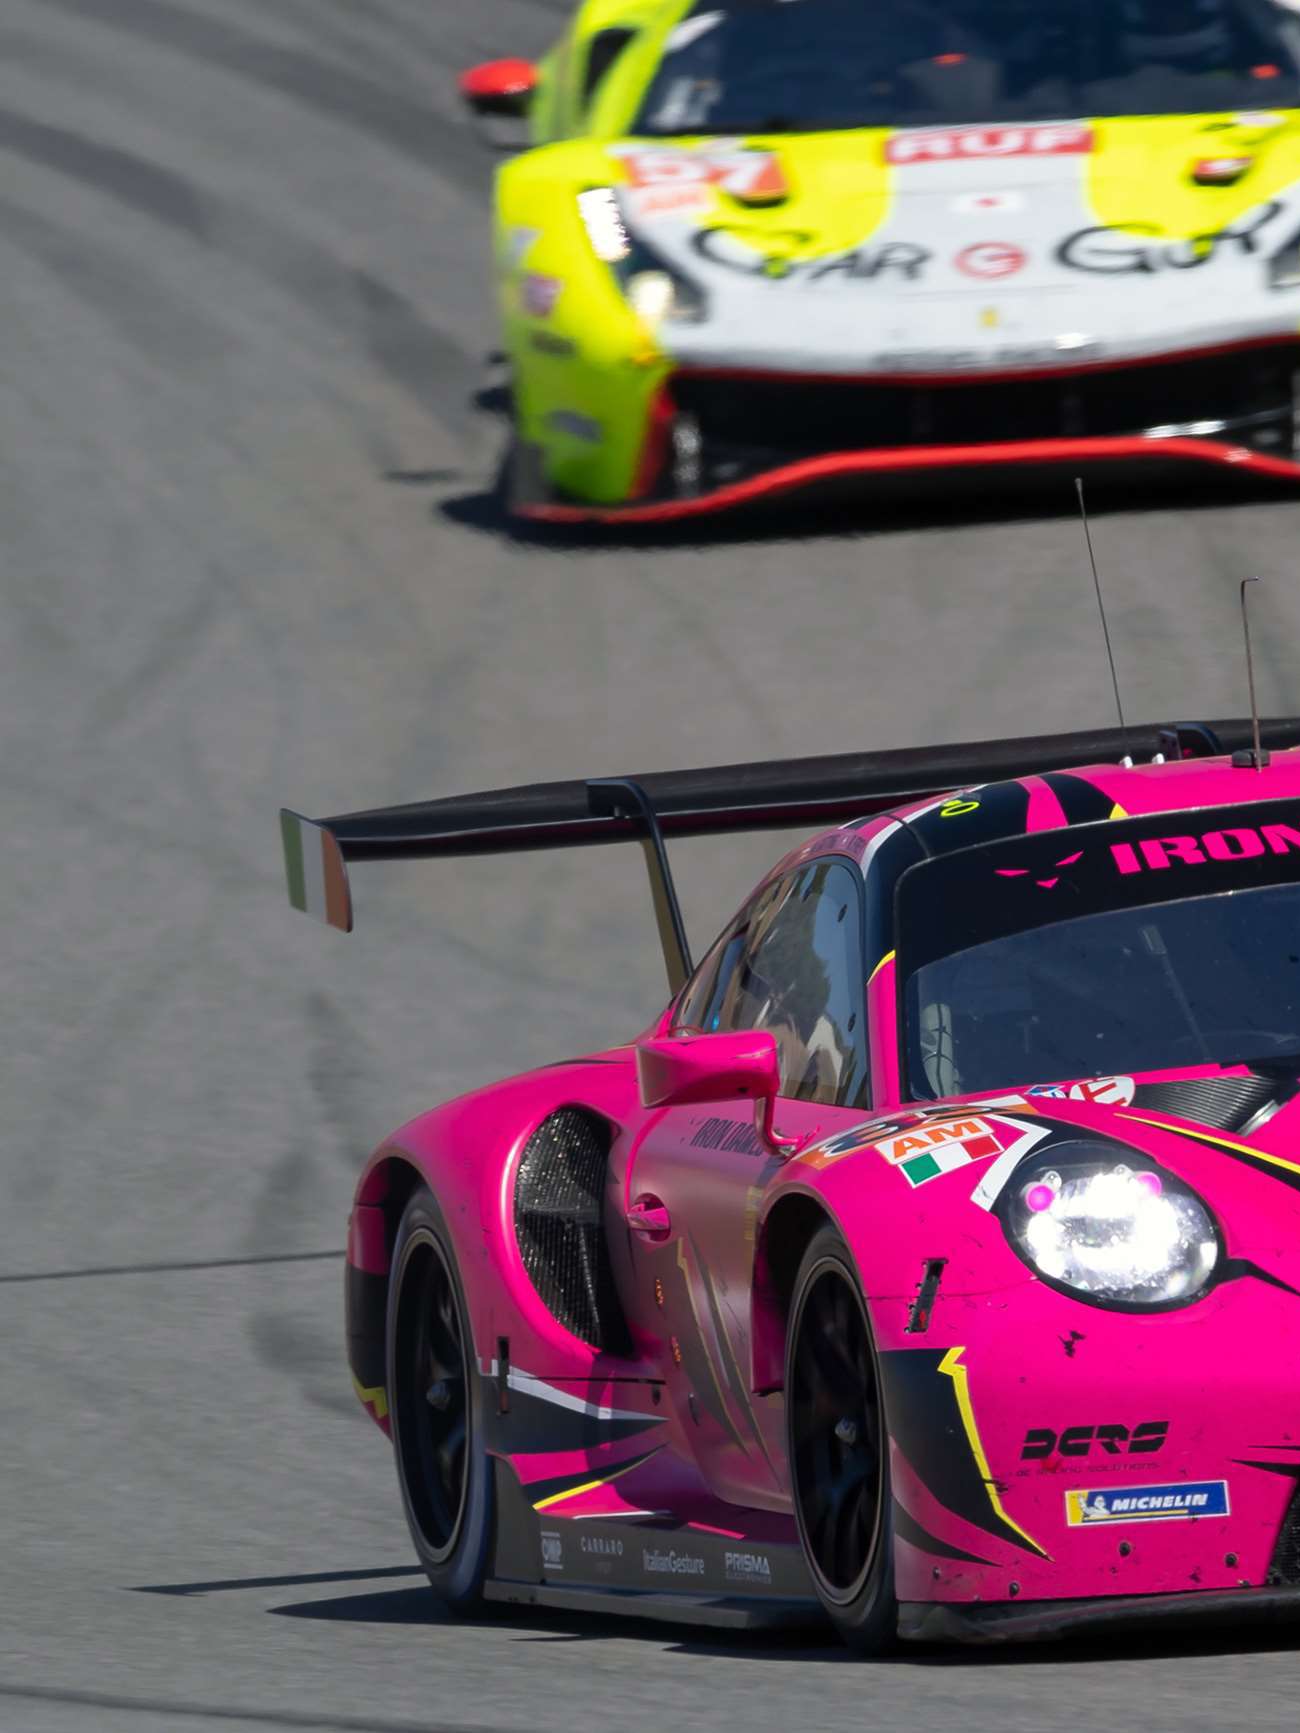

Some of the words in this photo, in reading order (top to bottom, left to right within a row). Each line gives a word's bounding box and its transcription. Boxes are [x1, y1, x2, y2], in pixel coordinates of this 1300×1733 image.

[891, 129, 1087, 160] RUF
[690, 223, 931, 281] CAR
[1054, 201, 1285, 274] GUY
[892, 1120, 984, 1160] AM
[1111, 1492, 1209, 1513] MICHELIN
[725, 1551, 771, 1574] PRISMA
